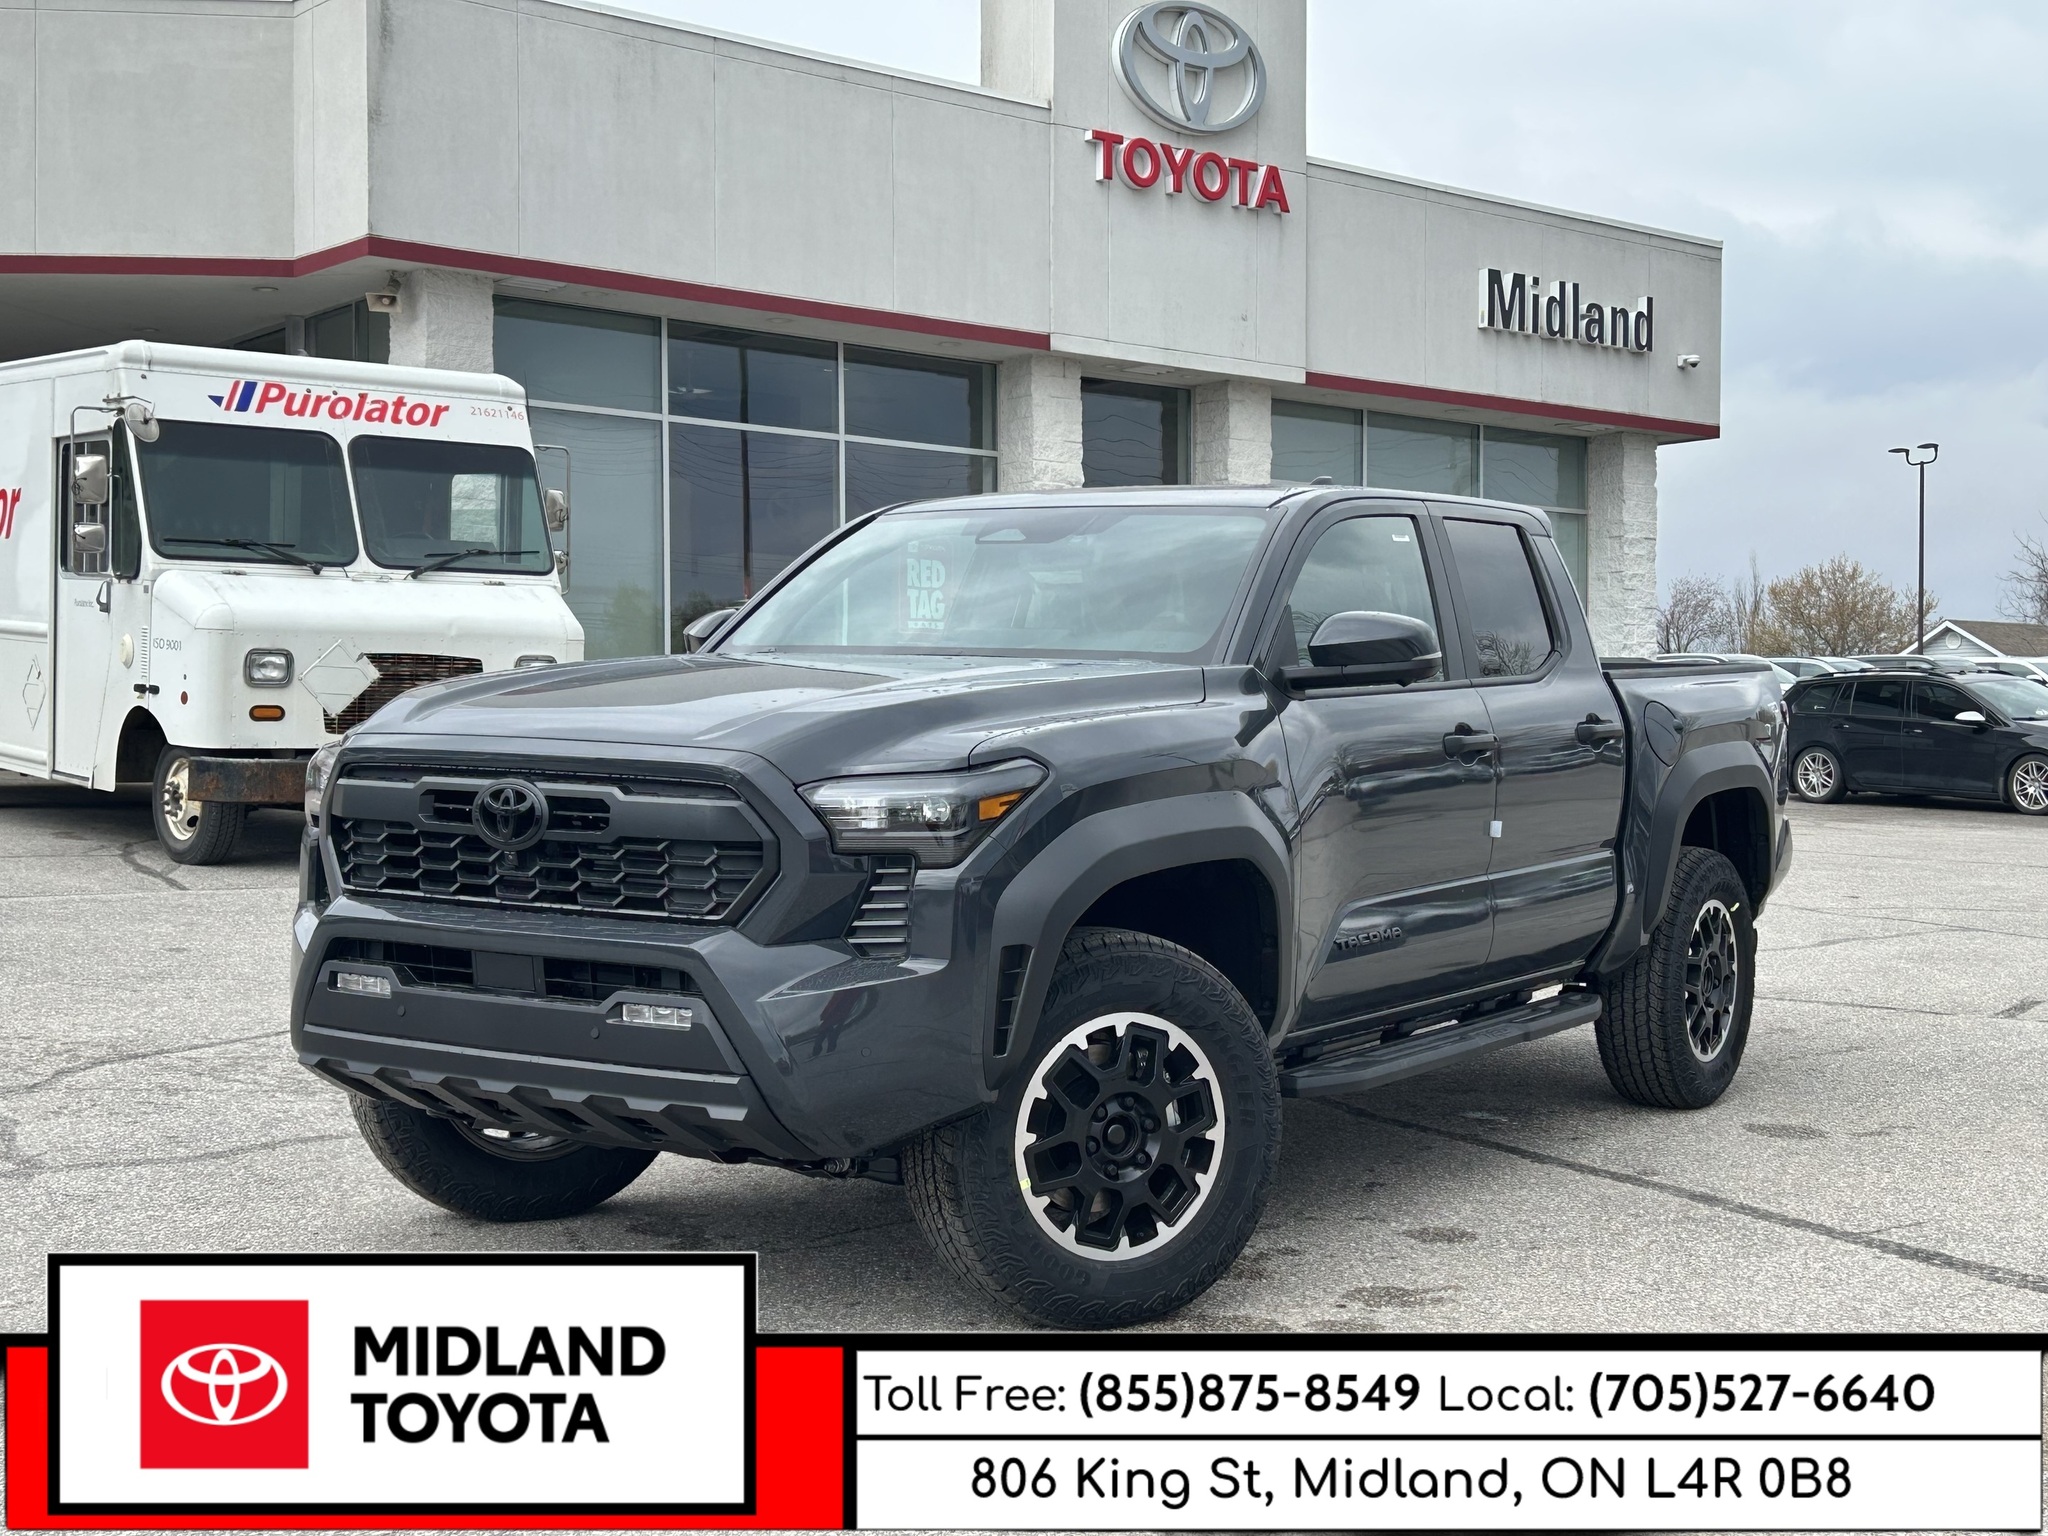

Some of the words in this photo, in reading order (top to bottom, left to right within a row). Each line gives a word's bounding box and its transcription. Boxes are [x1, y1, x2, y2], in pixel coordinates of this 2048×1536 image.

[1086, 129, 1291, 214] TOYOTA
[1480, 267, 1654, 353] Midland
[255, 382, 450, 428] Purolator
[470, 406, 525, 421] 21621146
[906, 558, 946, 589] RED
[906, 588, 946, 620] TAG
[166, 639, 182, 651] 9001
[1333, 926, 1403, 951] TACOMA
